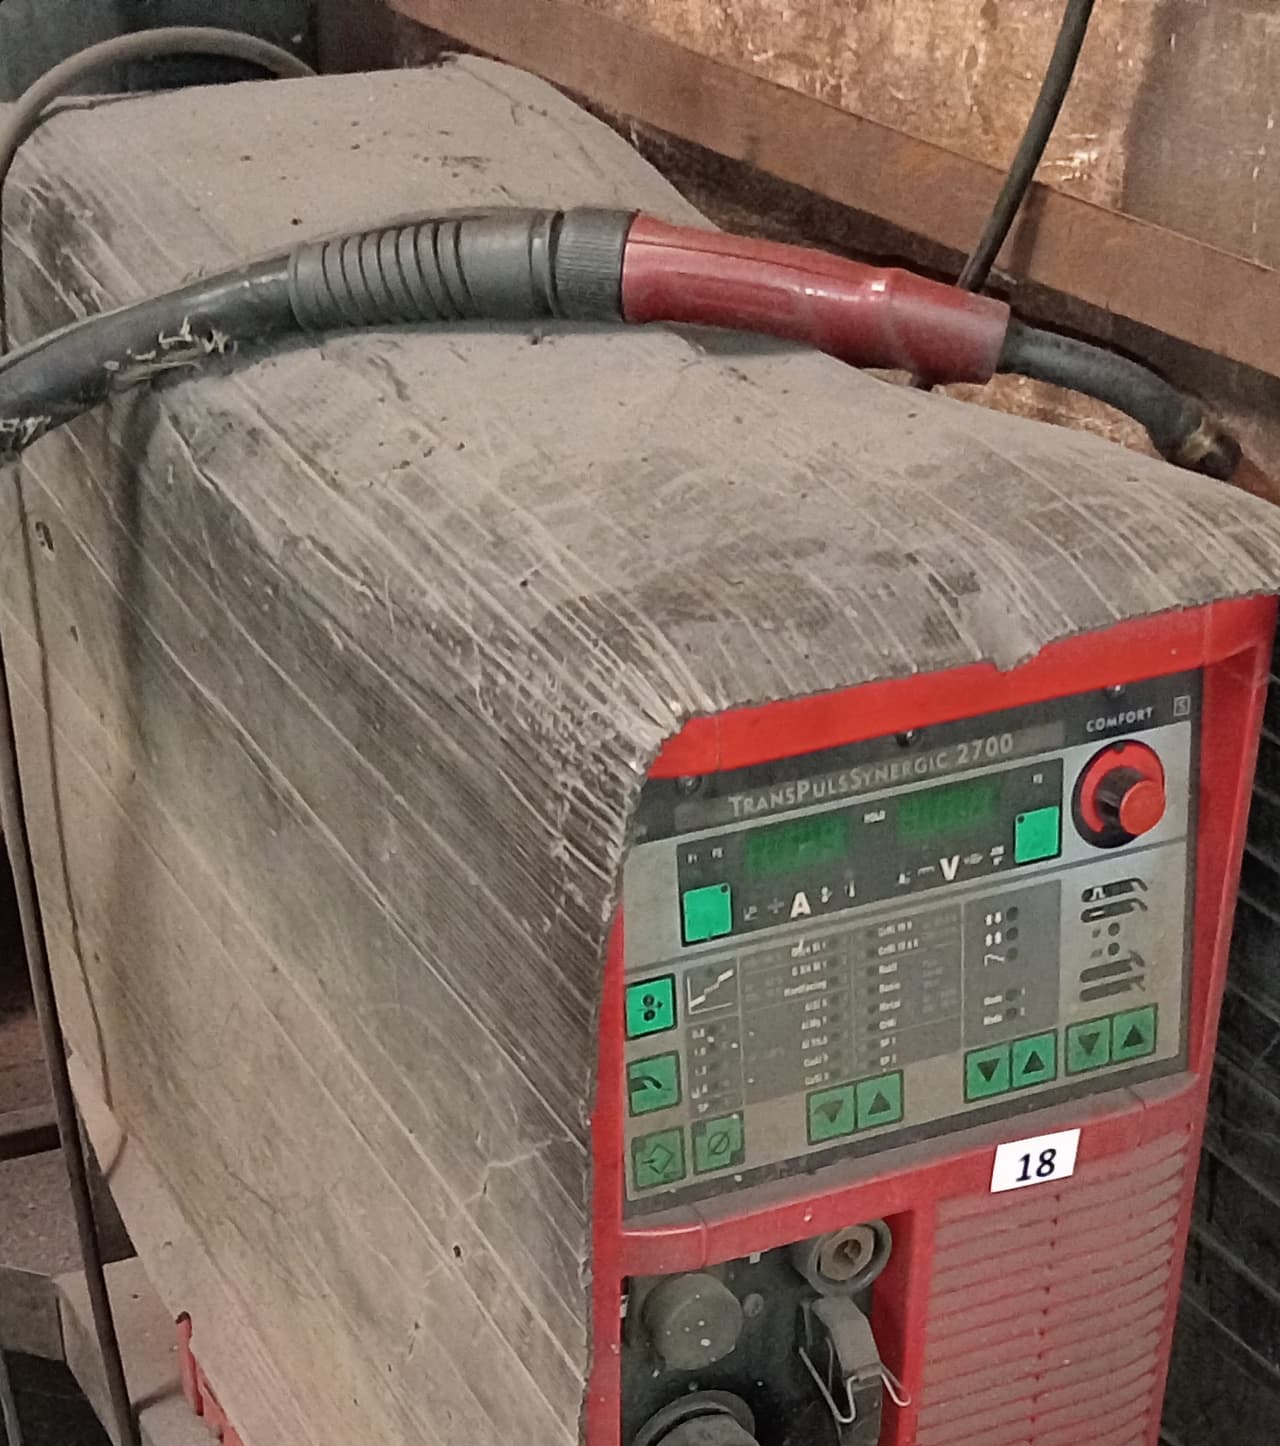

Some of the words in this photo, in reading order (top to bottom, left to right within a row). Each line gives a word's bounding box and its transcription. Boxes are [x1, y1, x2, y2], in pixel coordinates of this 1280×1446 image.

[1085, 706, 1154, 733] COMFORT
[955, 732, 1014, 765] 2700
[939, 854, 961, 882] V
[790, 891, 813, 919] A
[1016, 1147, 1058, 1183] 18
